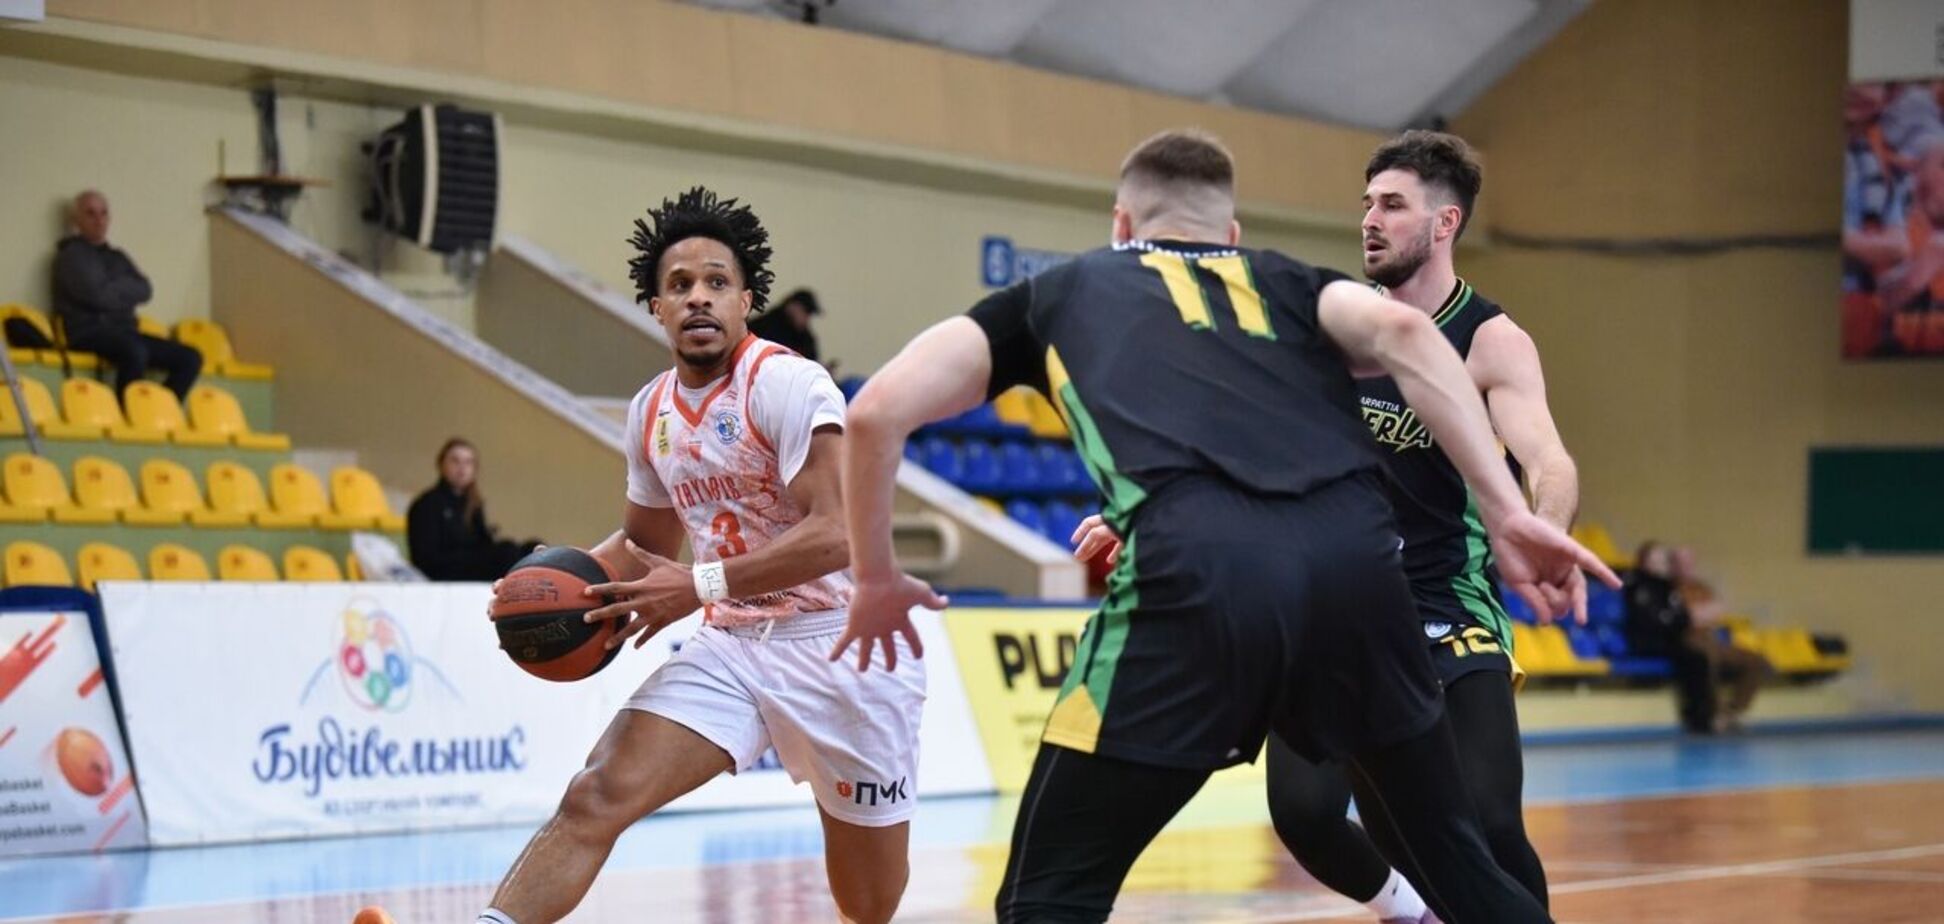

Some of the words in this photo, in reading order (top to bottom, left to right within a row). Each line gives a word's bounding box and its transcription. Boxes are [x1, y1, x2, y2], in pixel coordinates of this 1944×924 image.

[1139, 251, 1278, 342] 11
[712, 511, 747, 559] 3
[252, 716, 526, 797] Будівельник
